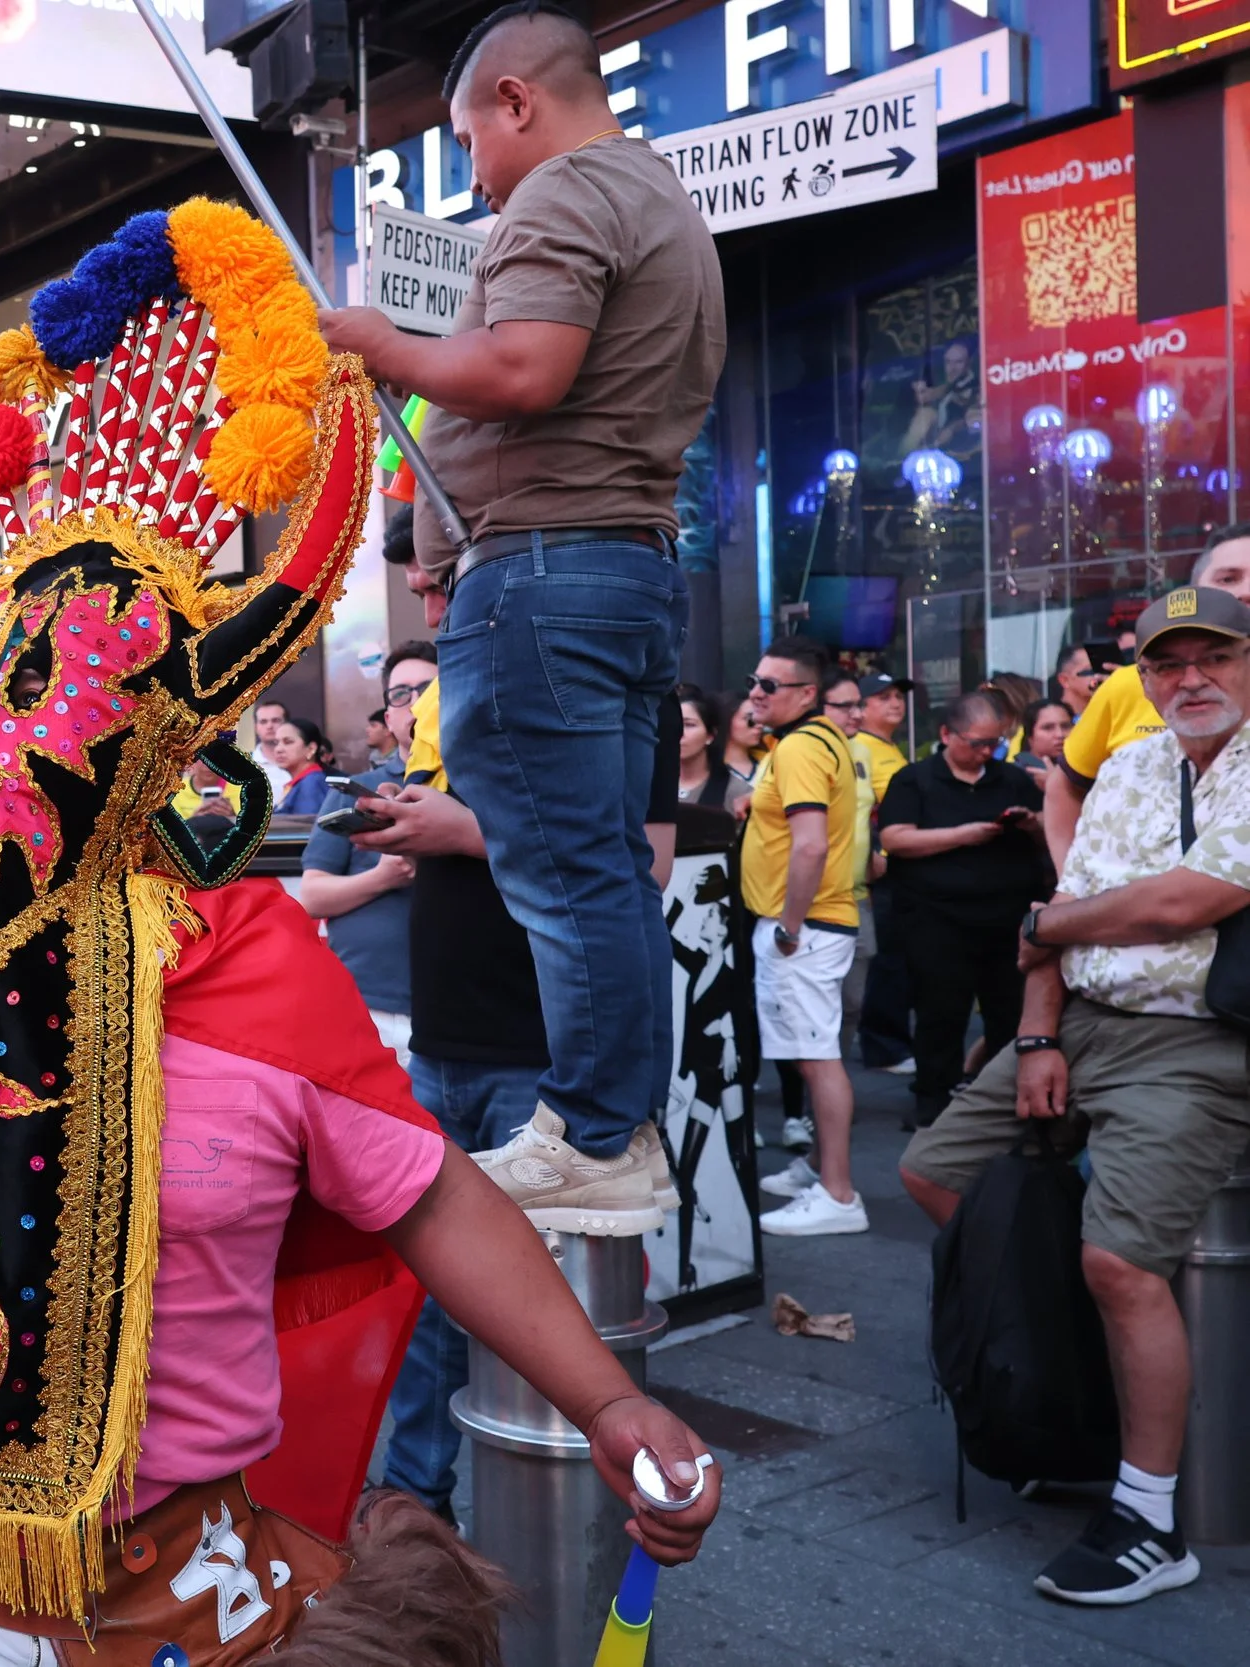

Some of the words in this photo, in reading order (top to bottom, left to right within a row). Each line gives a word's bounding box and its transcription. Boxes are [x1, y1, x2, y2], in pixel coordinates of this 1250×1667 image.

[664, 133, 752, 180] TRIAN
[763, 114, 832, 160] FLOW
[844, 95, 916, 142] ZONE
[381, 270, 420, 311] KEEP
[427, 281, 468, 319] MOVI
